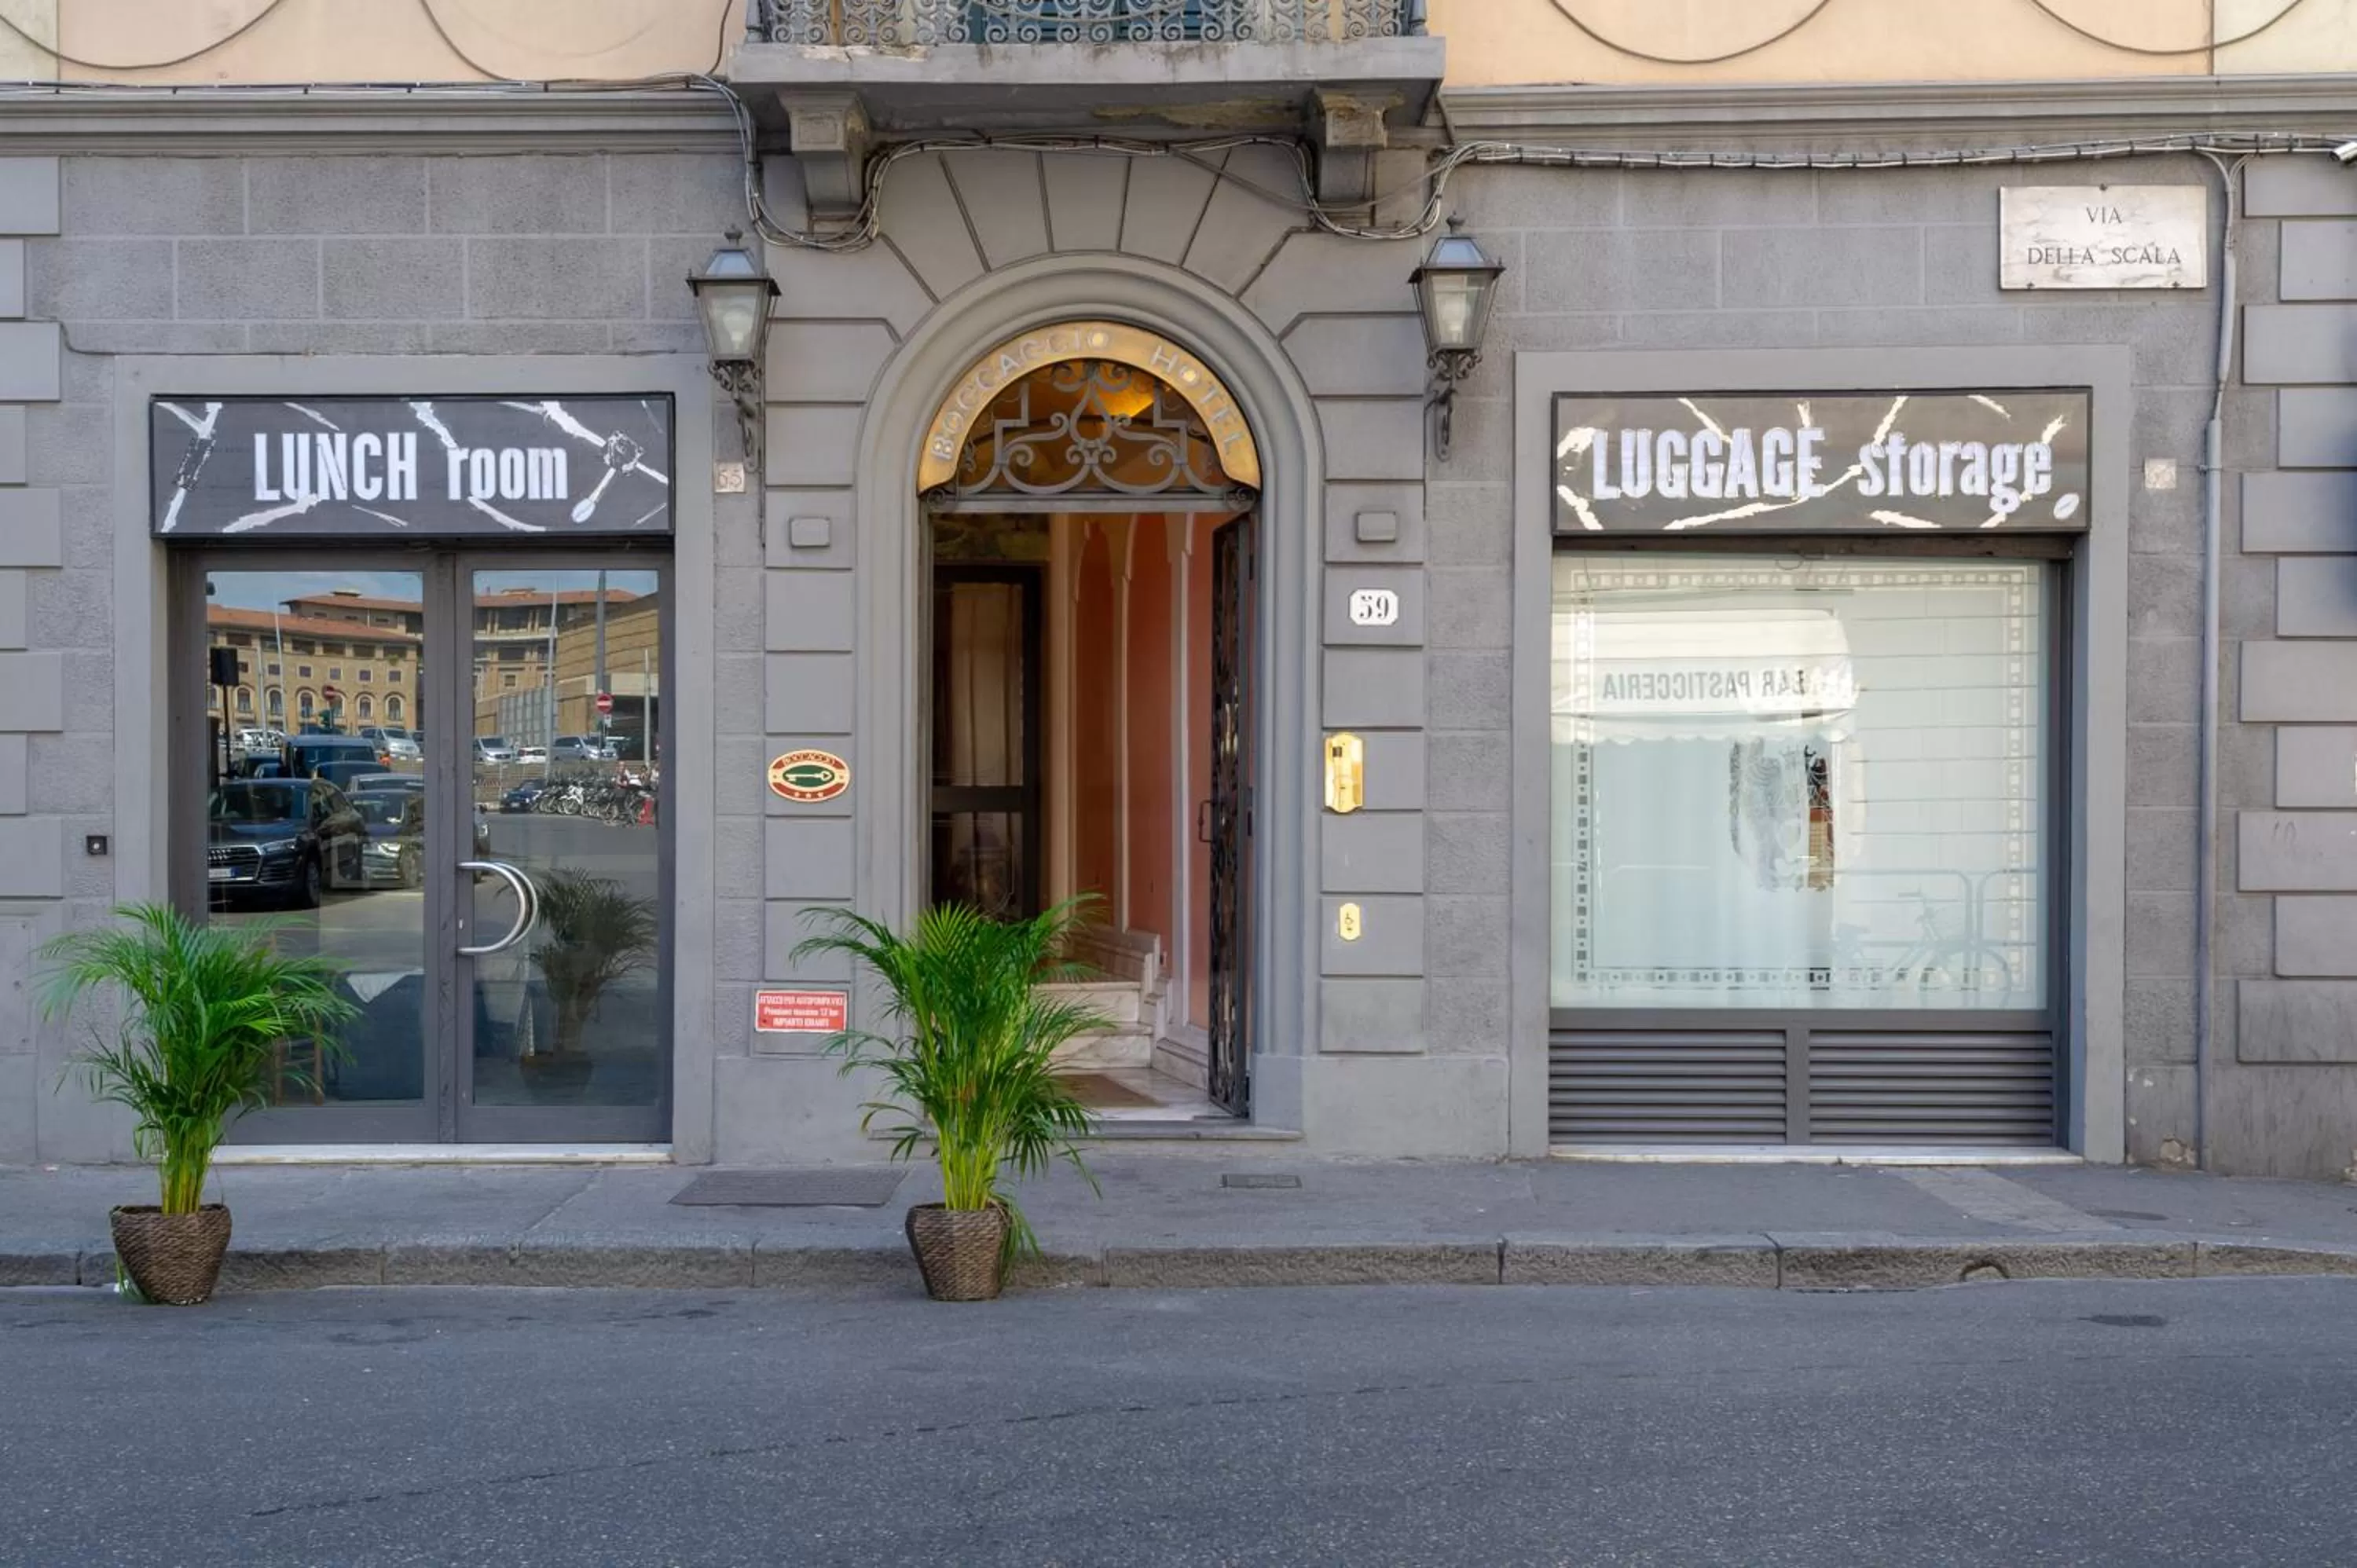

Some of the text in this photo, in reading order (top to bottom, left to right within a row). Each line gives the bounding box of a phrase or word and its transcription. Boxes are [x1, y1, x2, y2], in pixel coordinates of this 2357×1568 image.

[2085, 207, 2123, 225] VIA
[2027, 247, 2182, 265] DELLA SCALA
[1149, 344, 1243, 456] HOTEL
[254, 432, 568, 500] LUNCH room
[1592, 427, 2053, 514] LUGGAGE storage
[1359, 595, 1390, 621] 59
